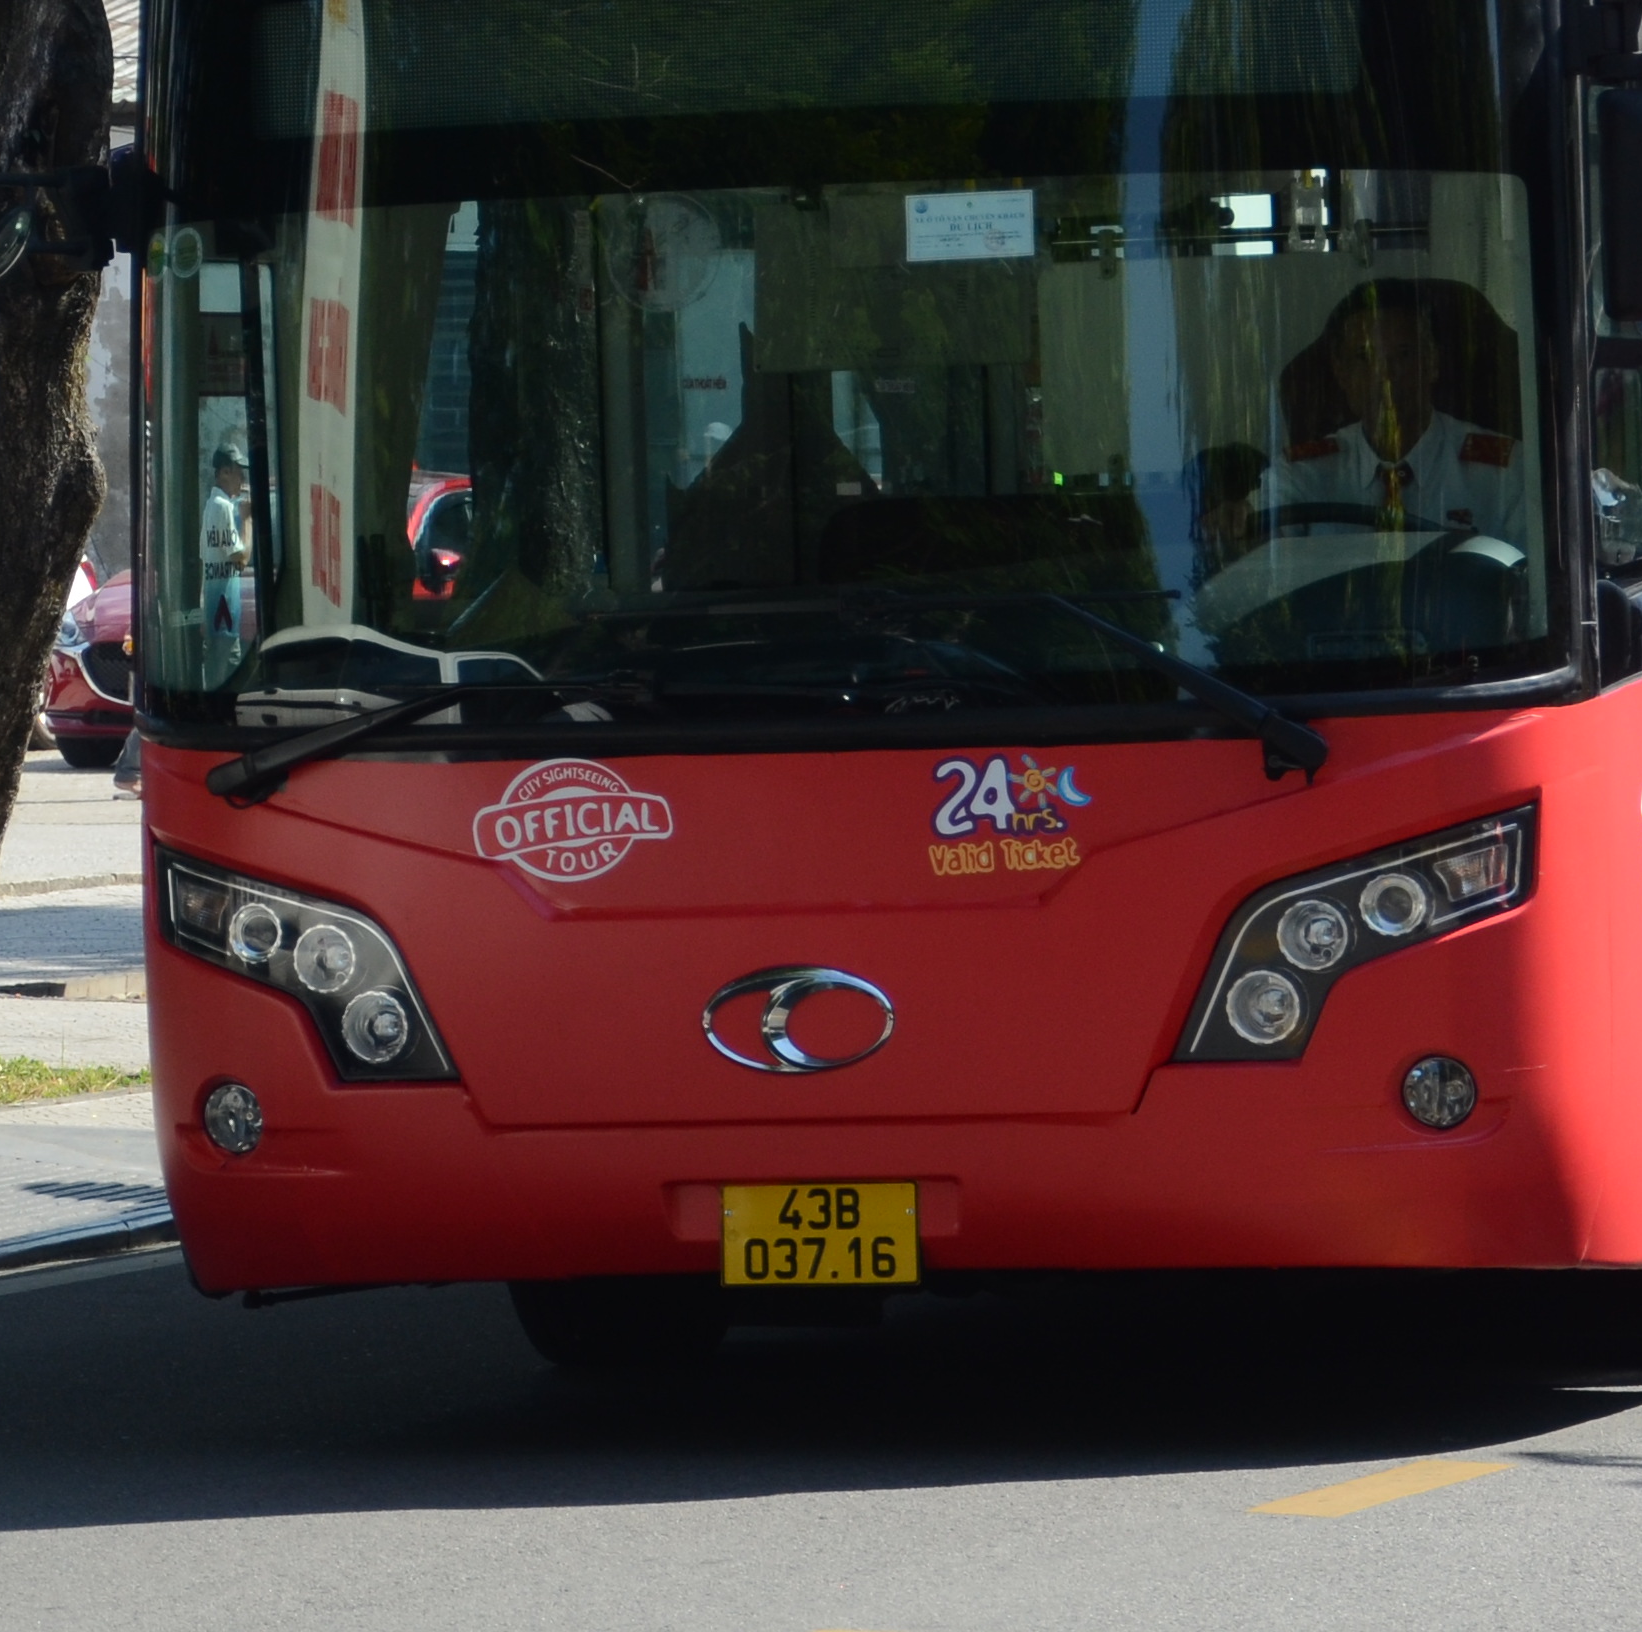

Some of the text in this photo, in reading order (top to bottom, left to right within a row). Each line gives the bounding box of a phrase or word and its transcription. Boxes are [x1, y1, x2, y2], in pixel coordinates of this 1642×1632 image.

[518, 767, 619, 801] CITY SIGHTSEEING
[495, 801, 660, 849] OFFICIAL
[545, 841, 619, 873] TOUR
[928, 836, 1081, 876] Valid Ticket
[778, 1187, 861, 1231] 43B
[743, 1236, 897, 1281] 037.16
